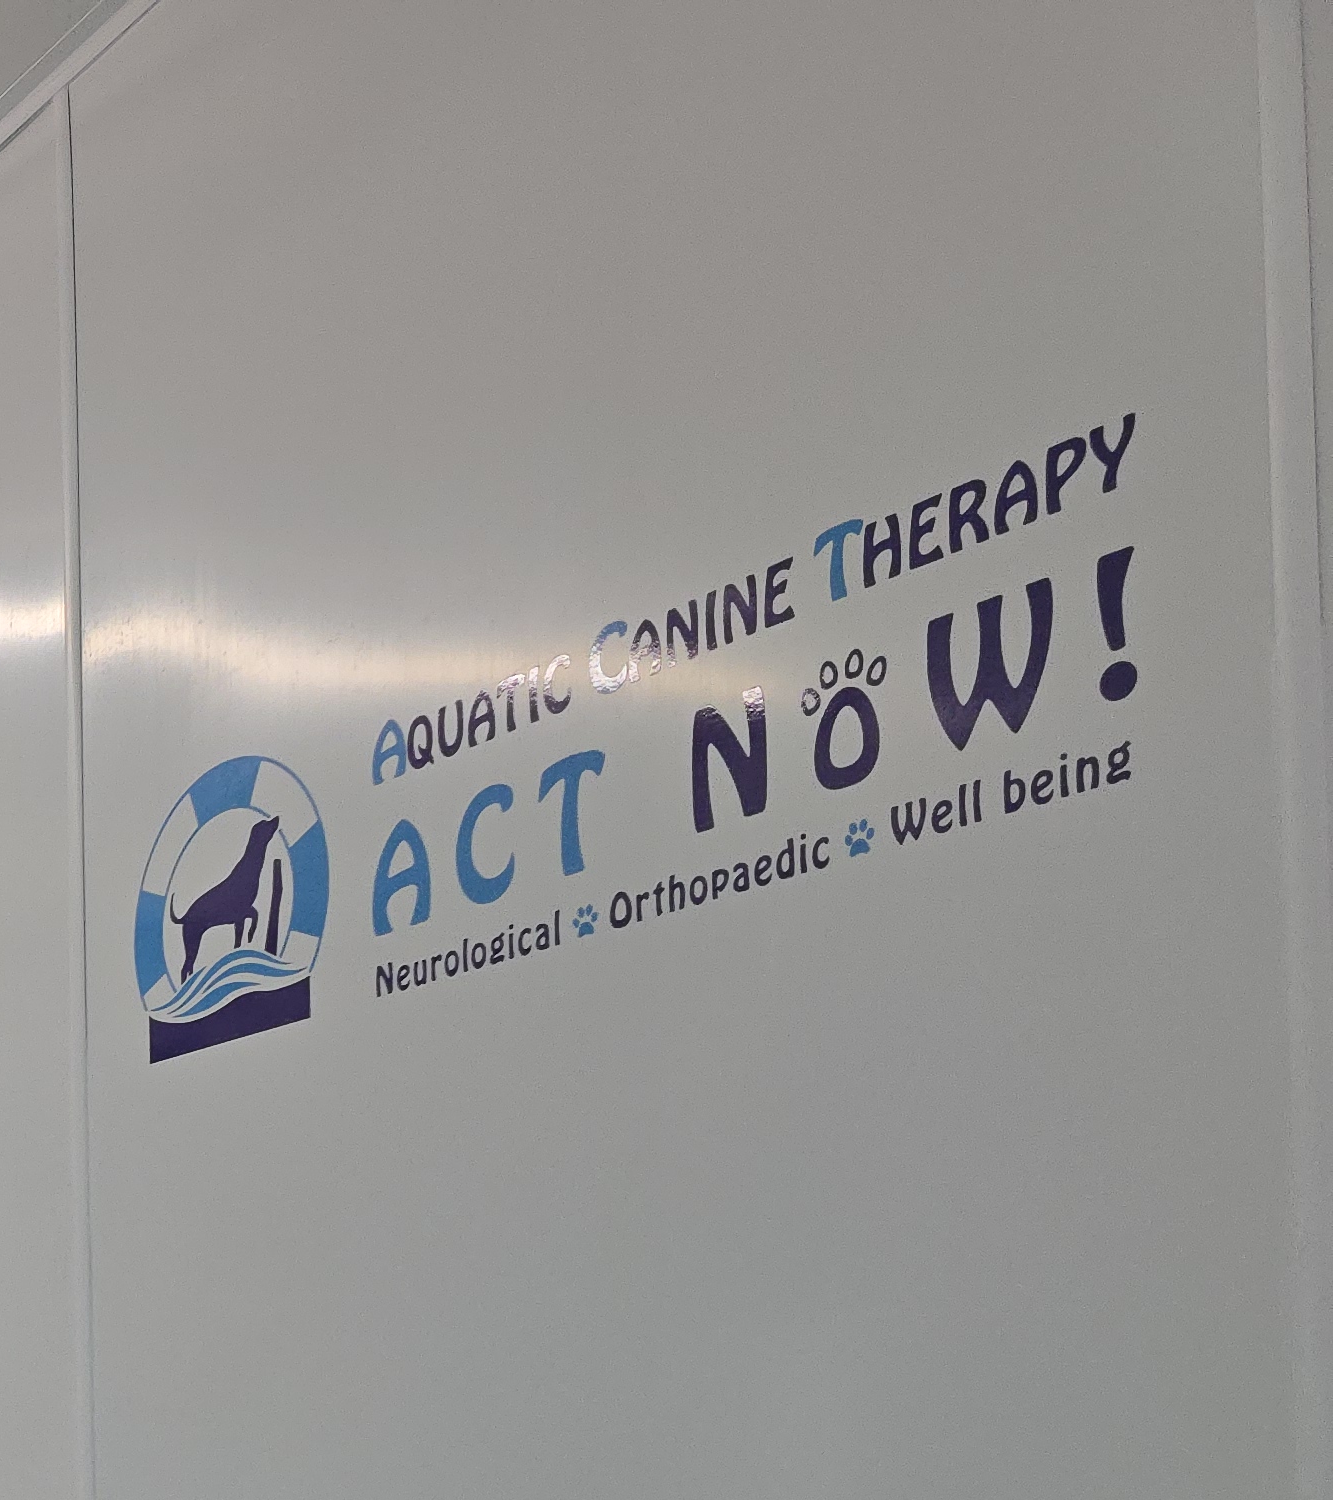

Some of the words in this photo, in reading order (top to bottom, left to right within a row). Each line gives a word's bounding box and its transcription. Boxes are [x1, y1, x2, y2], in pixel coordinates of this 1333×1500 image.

[372, 654, 572, 786] AQUATIC
[588, 556, 795, 695] CANINE
[813, 412, 1136, 602] THERAPY
[372, 749, 606, 937] ACT
[375, 910, 561, 998] Neurological
[609, 833, 831, 930] Orthopaedic
[890, 779, 983, 846] Well
[1004, 741, 1132, 815] being
